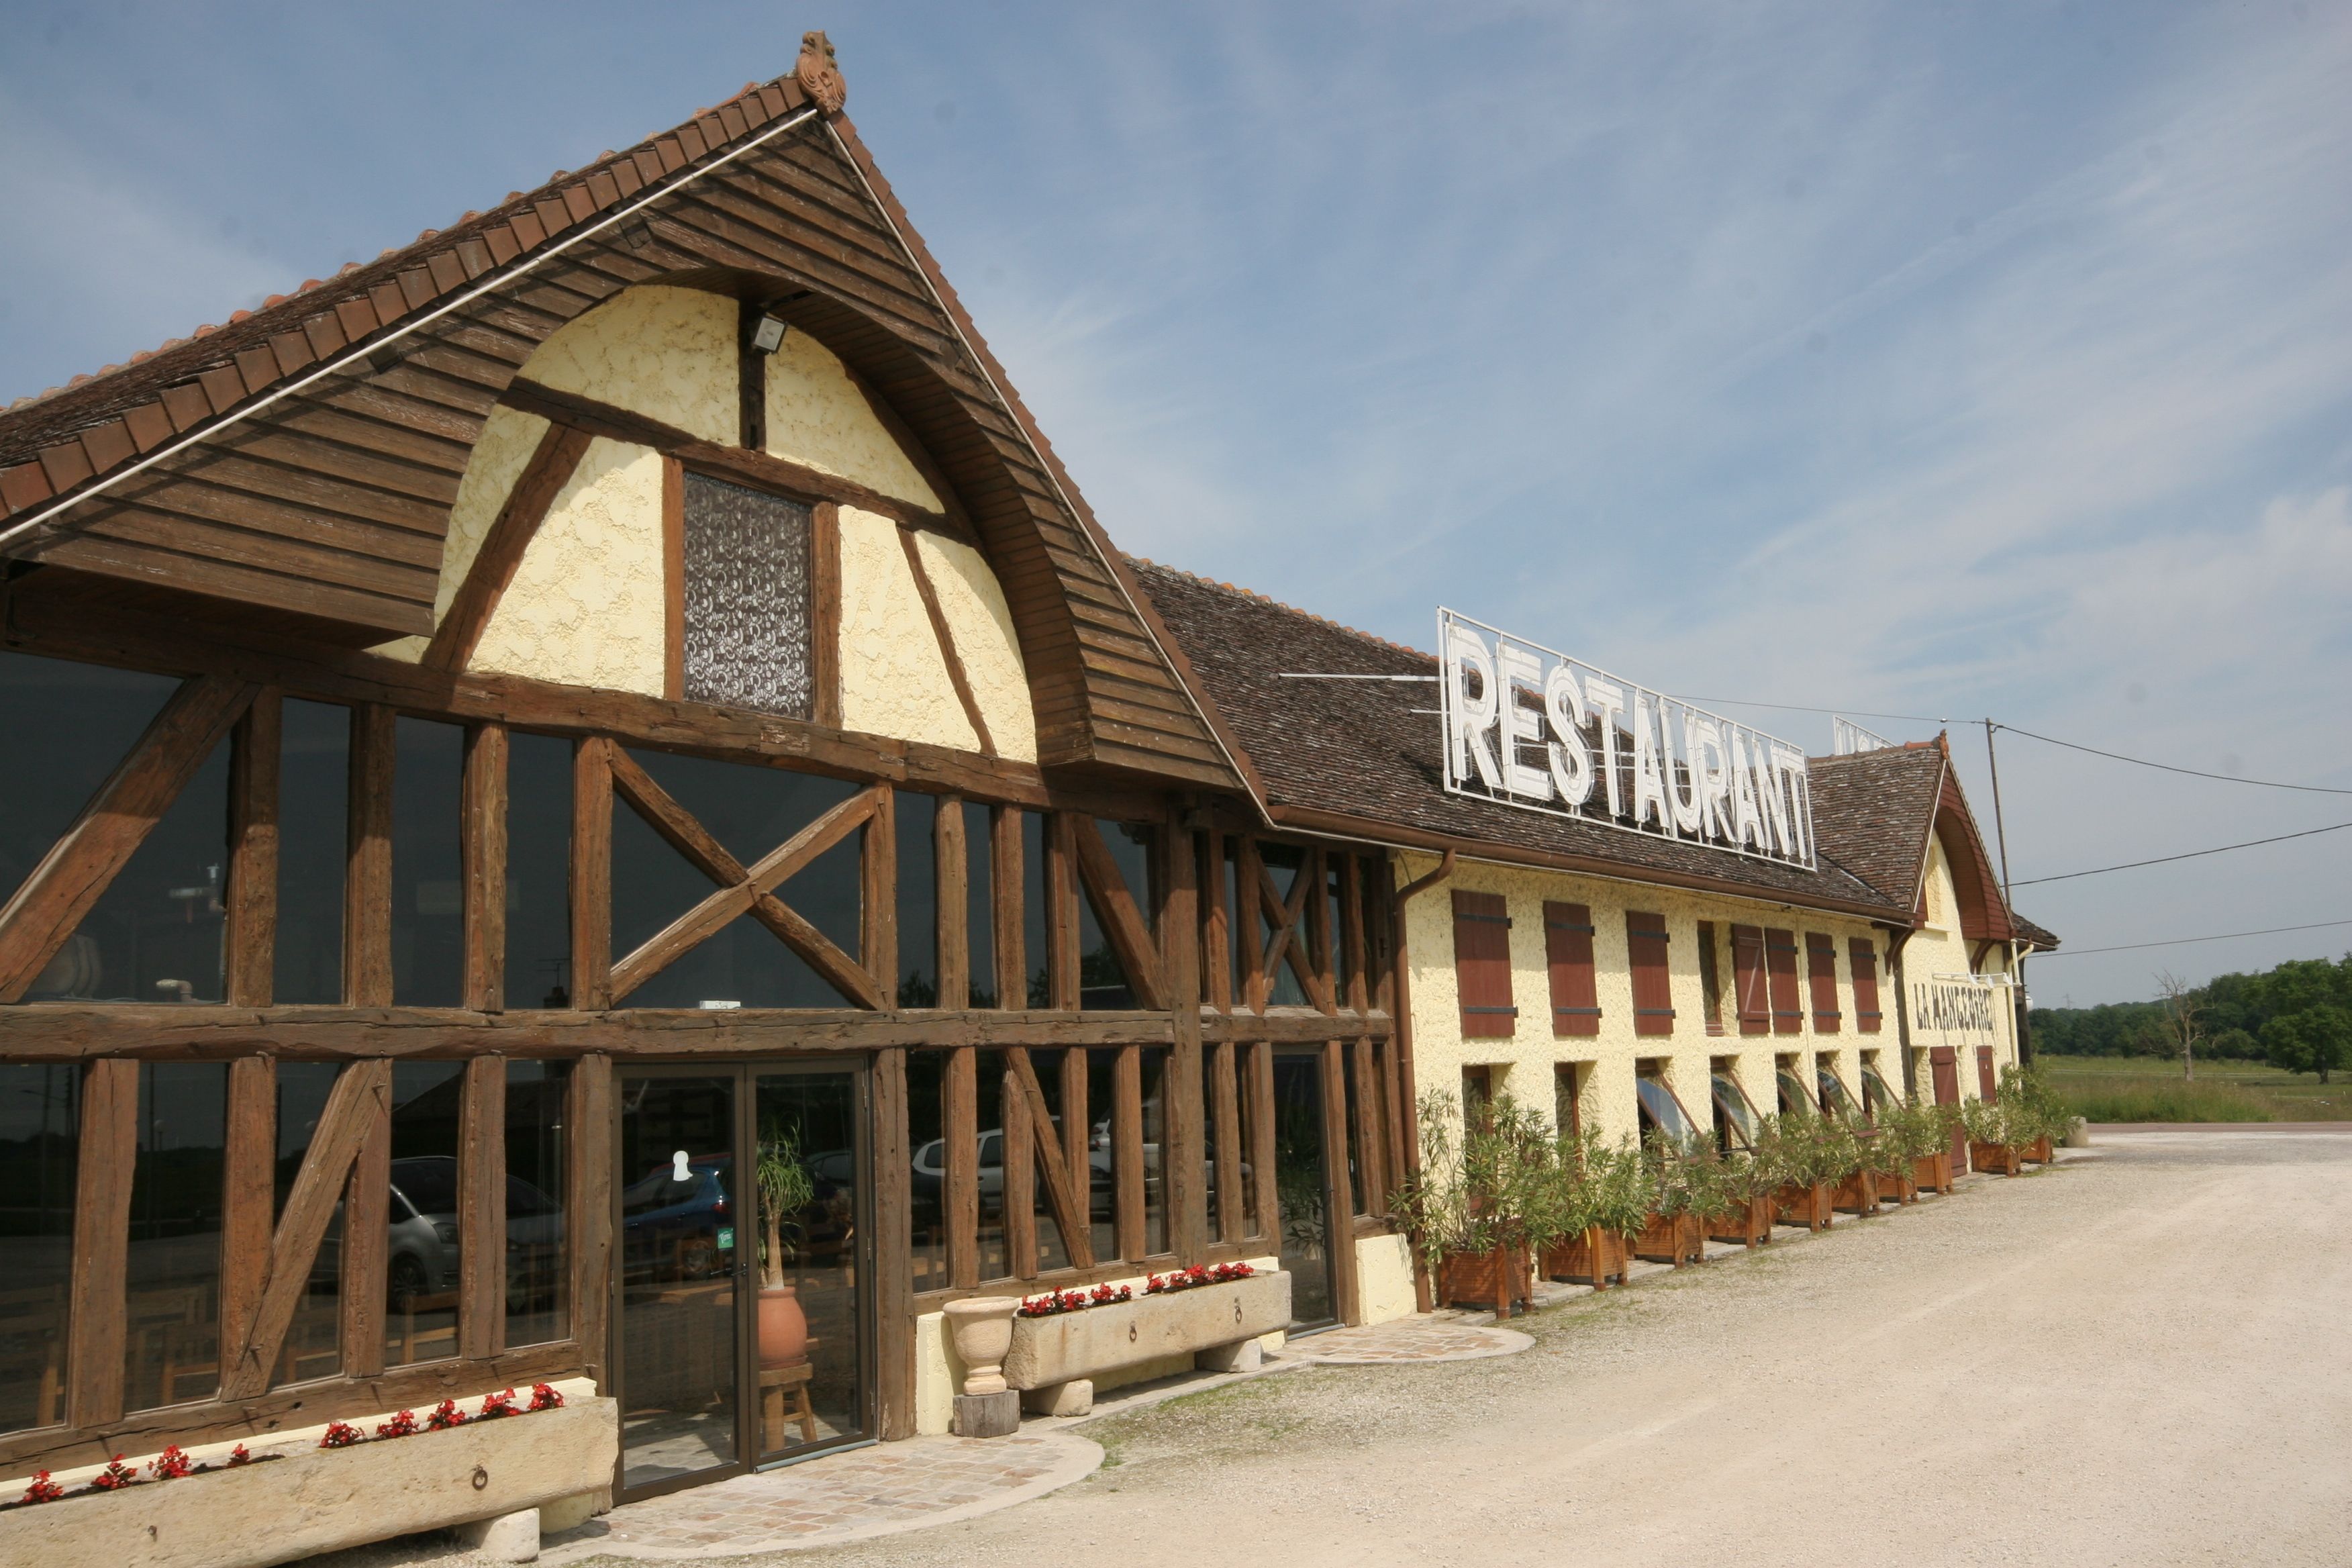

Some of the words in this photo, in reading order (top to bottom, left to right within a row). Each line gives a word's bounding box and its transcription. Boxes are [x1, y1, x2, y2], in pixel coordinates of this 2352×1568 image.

[1445, 621, 1807, 862] RESTAURANT
[1914, 983, 1931, 1030] LA
[1931, 983, 1993, 1032] MANGEOIRE
